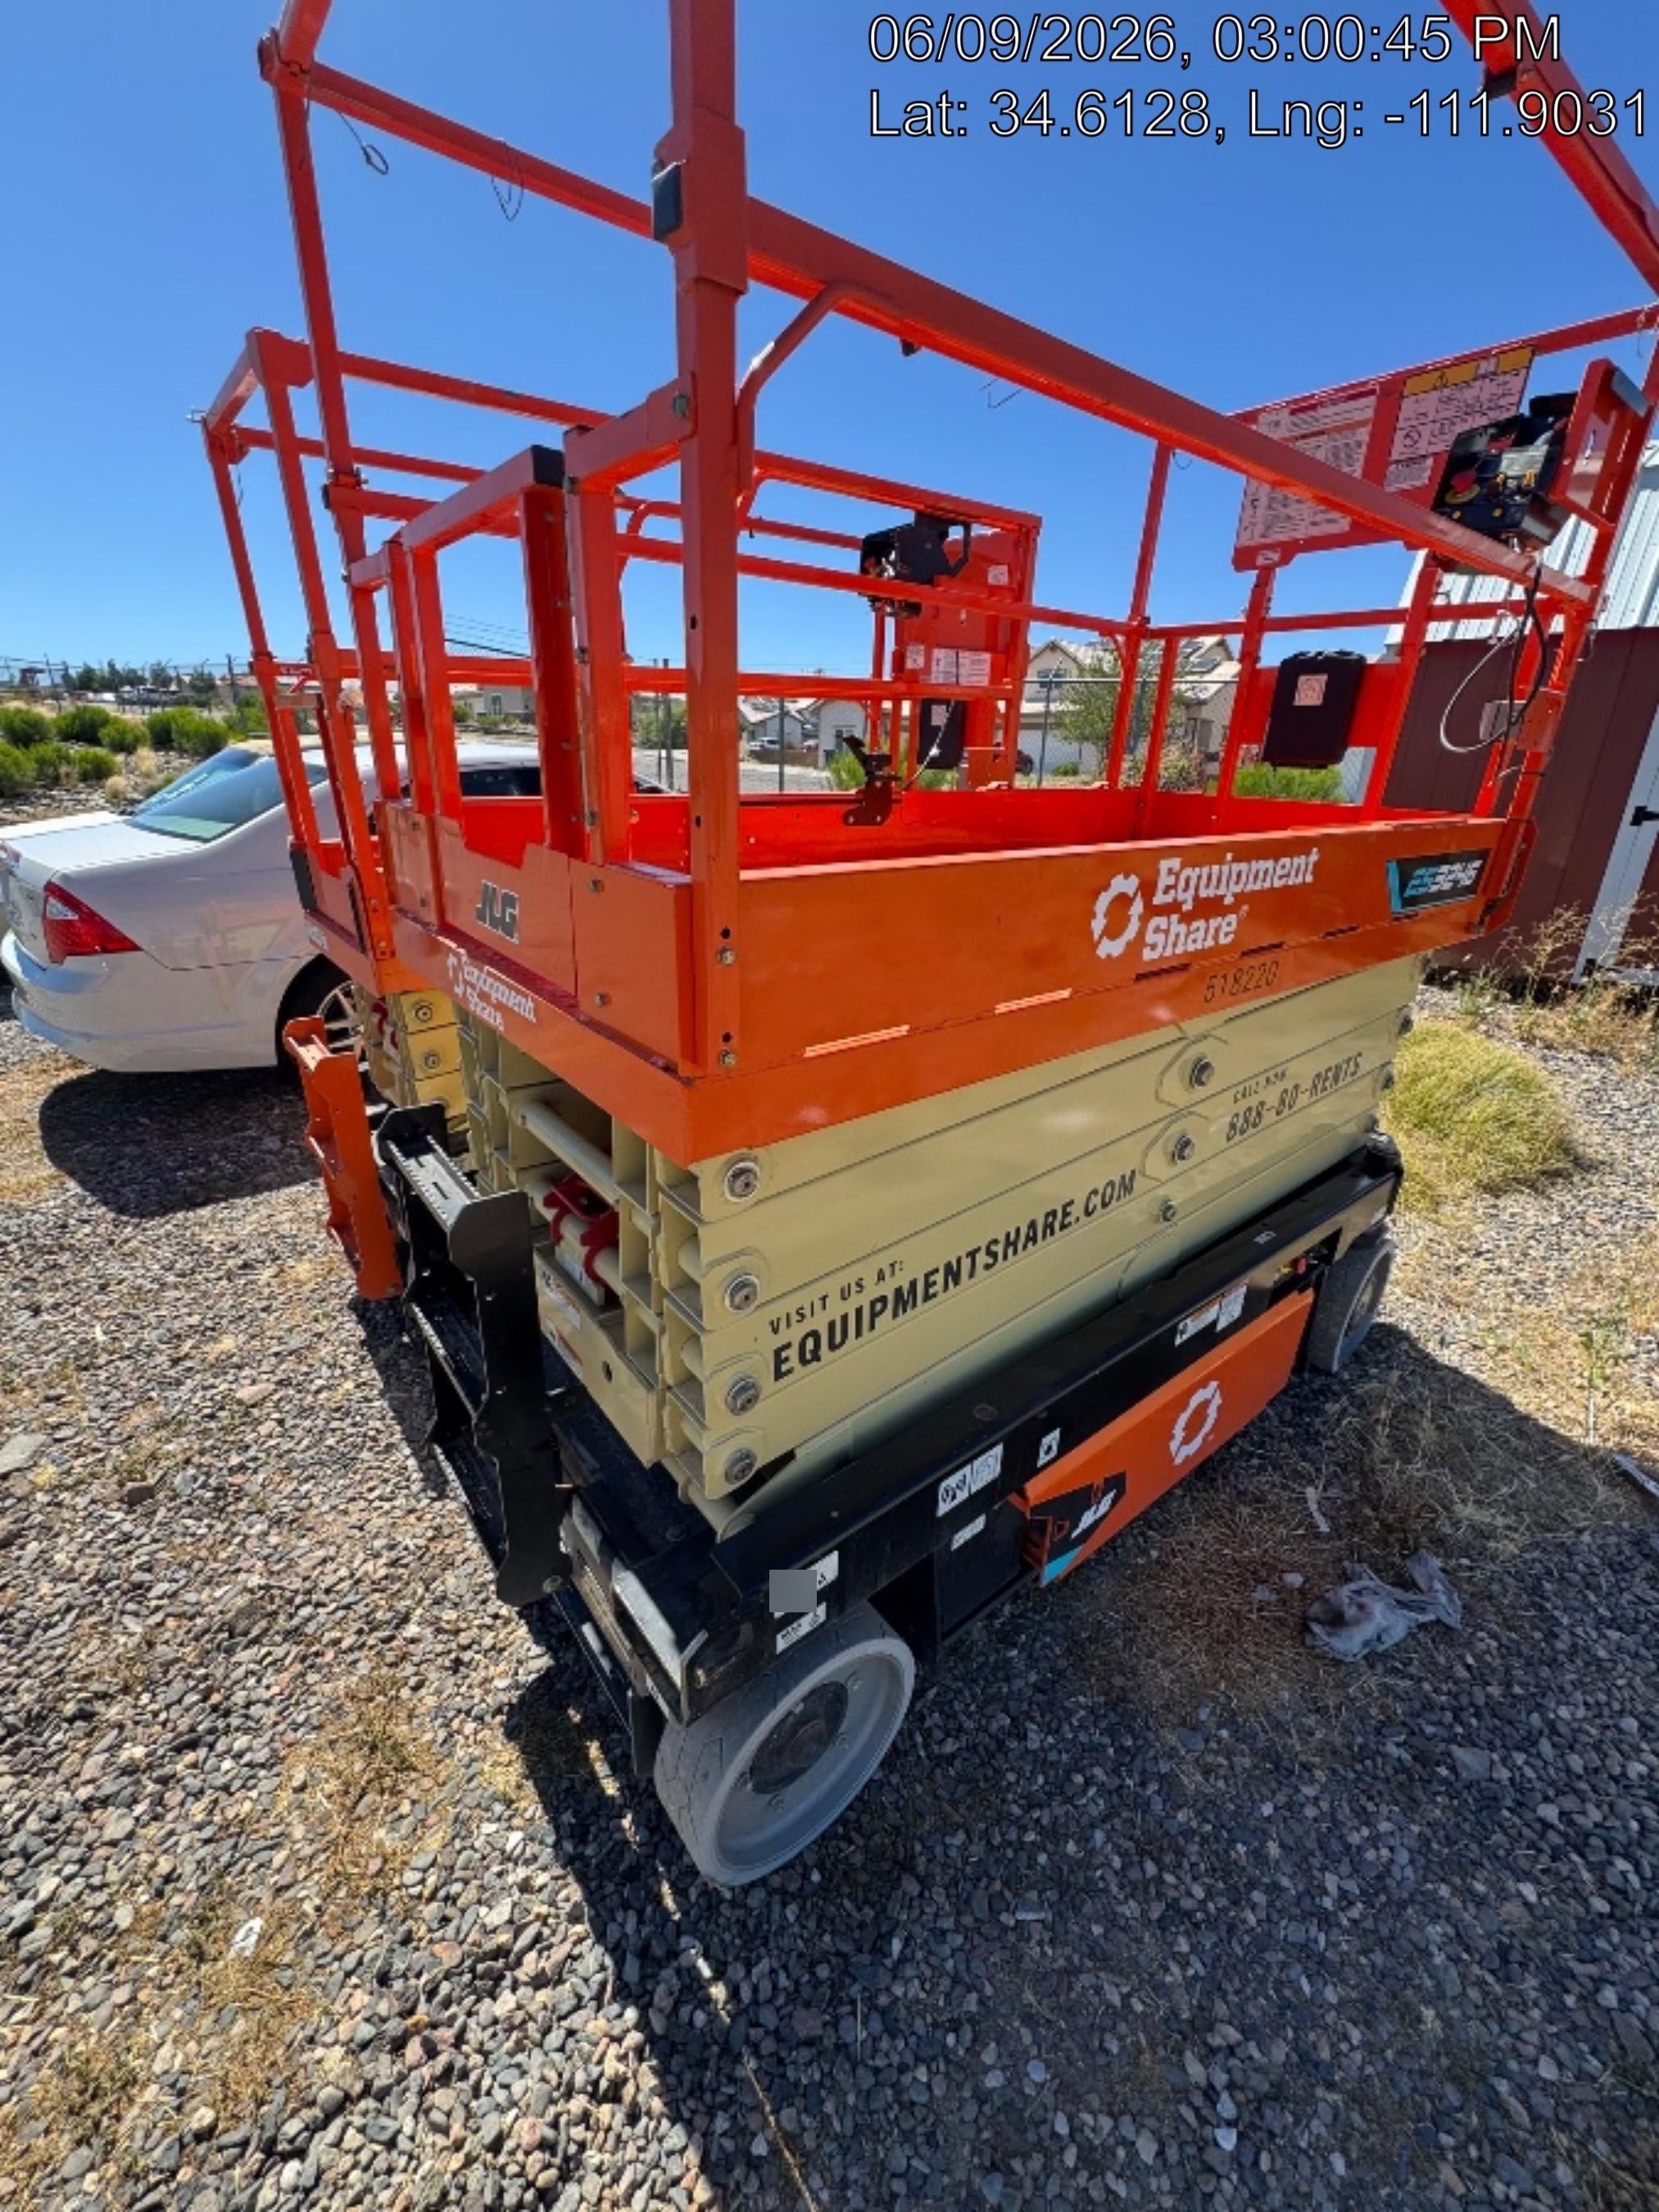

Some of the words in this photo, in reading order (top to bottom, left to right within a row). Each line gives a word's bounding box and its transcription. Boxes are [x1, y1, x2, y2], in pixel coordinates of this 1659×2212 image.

[1153, 846, 1321, 911] Equipment
[475, 879, 519, 945] JLG
[1203, 960, 1280, 1004] 518220
[769, 1294, 829, 1336] VISIT
[840, 1276, 866, 1303] US
[875, 1258, 904, 1287] AT:
[773, 1169, 1137, 1383] EQUIPMENTSHARE.COM
